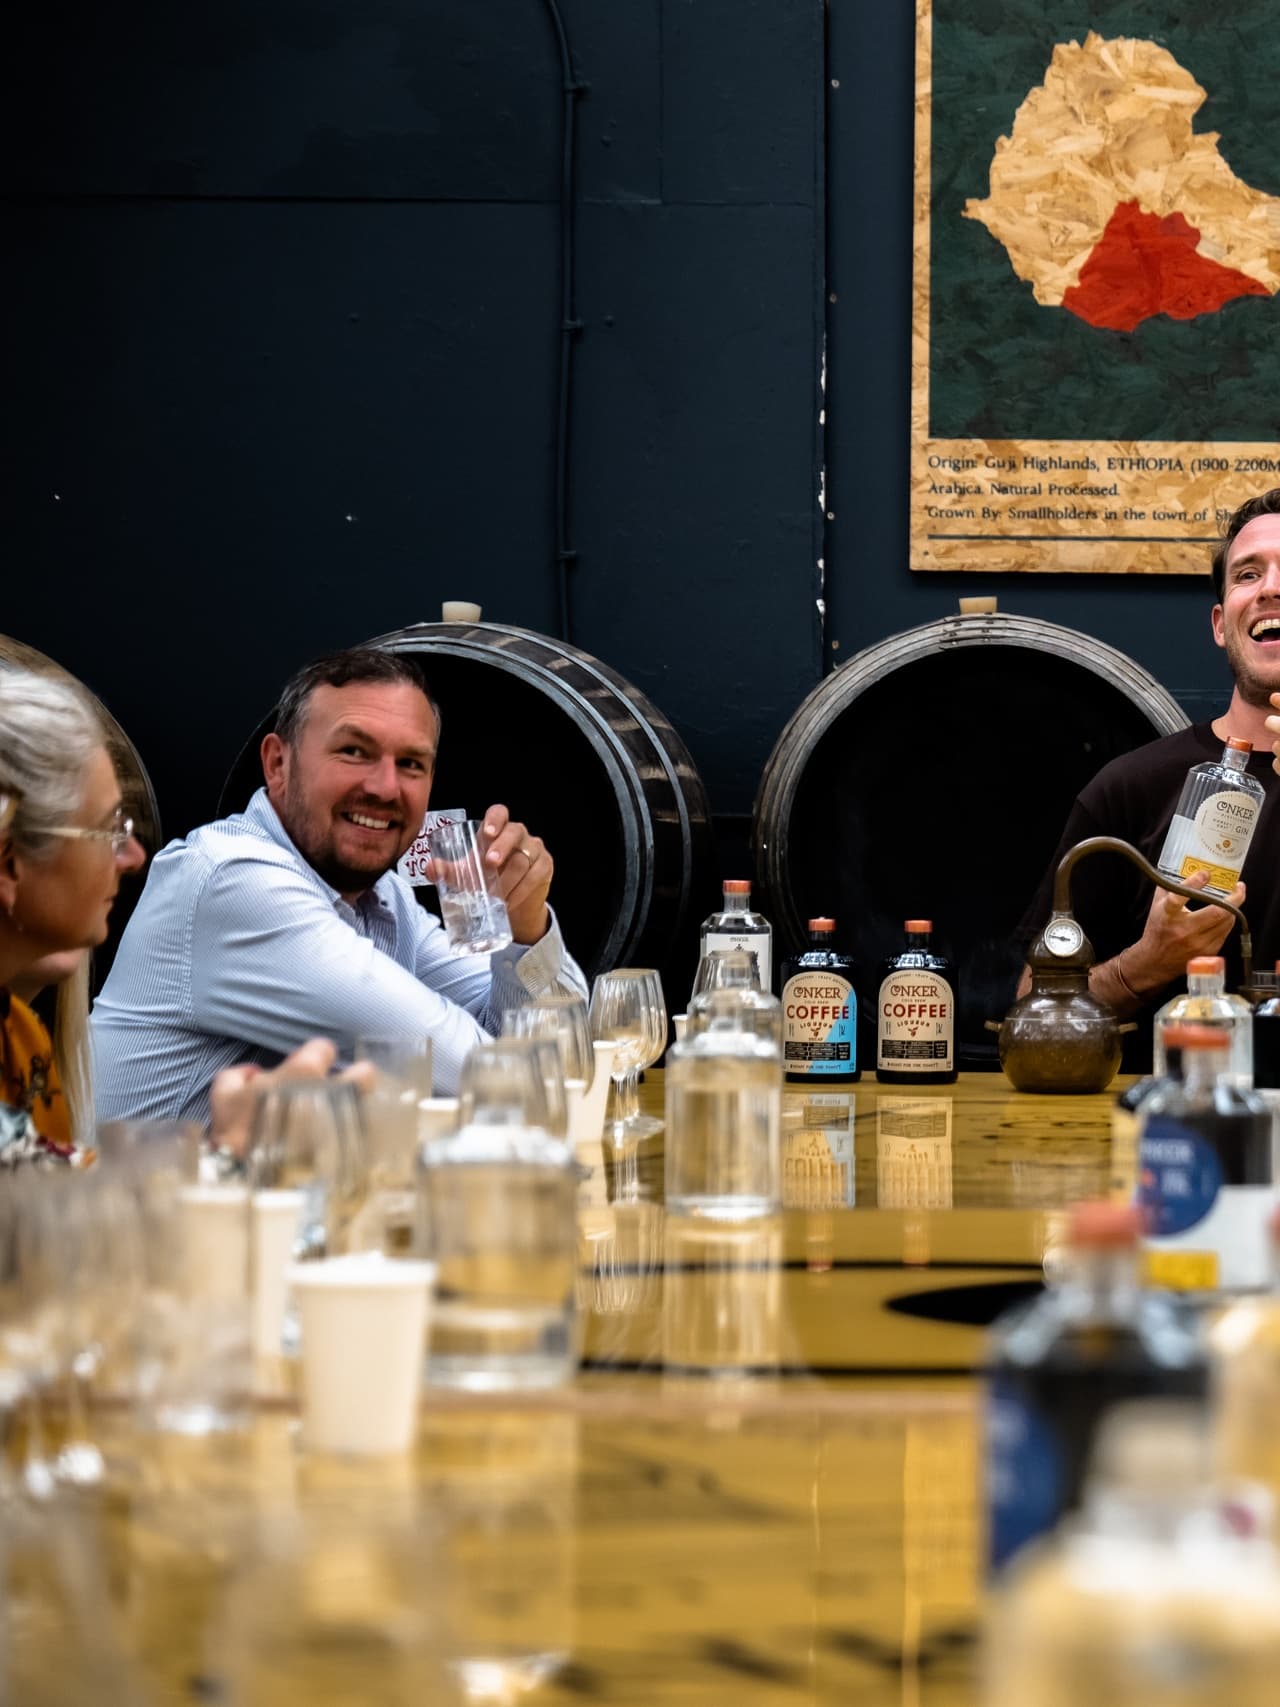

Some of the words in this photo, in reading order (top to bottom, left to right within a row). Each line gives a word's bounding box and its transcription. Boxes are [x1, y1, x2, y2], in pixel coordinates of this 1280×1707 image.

[928, 456, 977, 472] Origin:
[984, 456, 1016, 473] Guji
[1023, 456, 1100, 473] Highlands,
[1107, 457, 1184, 472] ETHIOPIA
[991, 483, 1041, 496] Natural
[928, 505, 974, 519] Grown
[1008, 506, 1098, 520] Smallholders
[1105, 507, 1117, 520] in
[1124, 508, 1146, 520] the
[1152, 509, 1187, 520] town
[1193, 508, 1208, 521] of
[1217, 800, 1254, 820] CONKER
[793, 986, 842, 999] CONKER
[890, 984, 939, 998] CONKER
[786, 1004, 849, 1020] COFFEE
[883, 1003, 947, 1018] COFFEE
